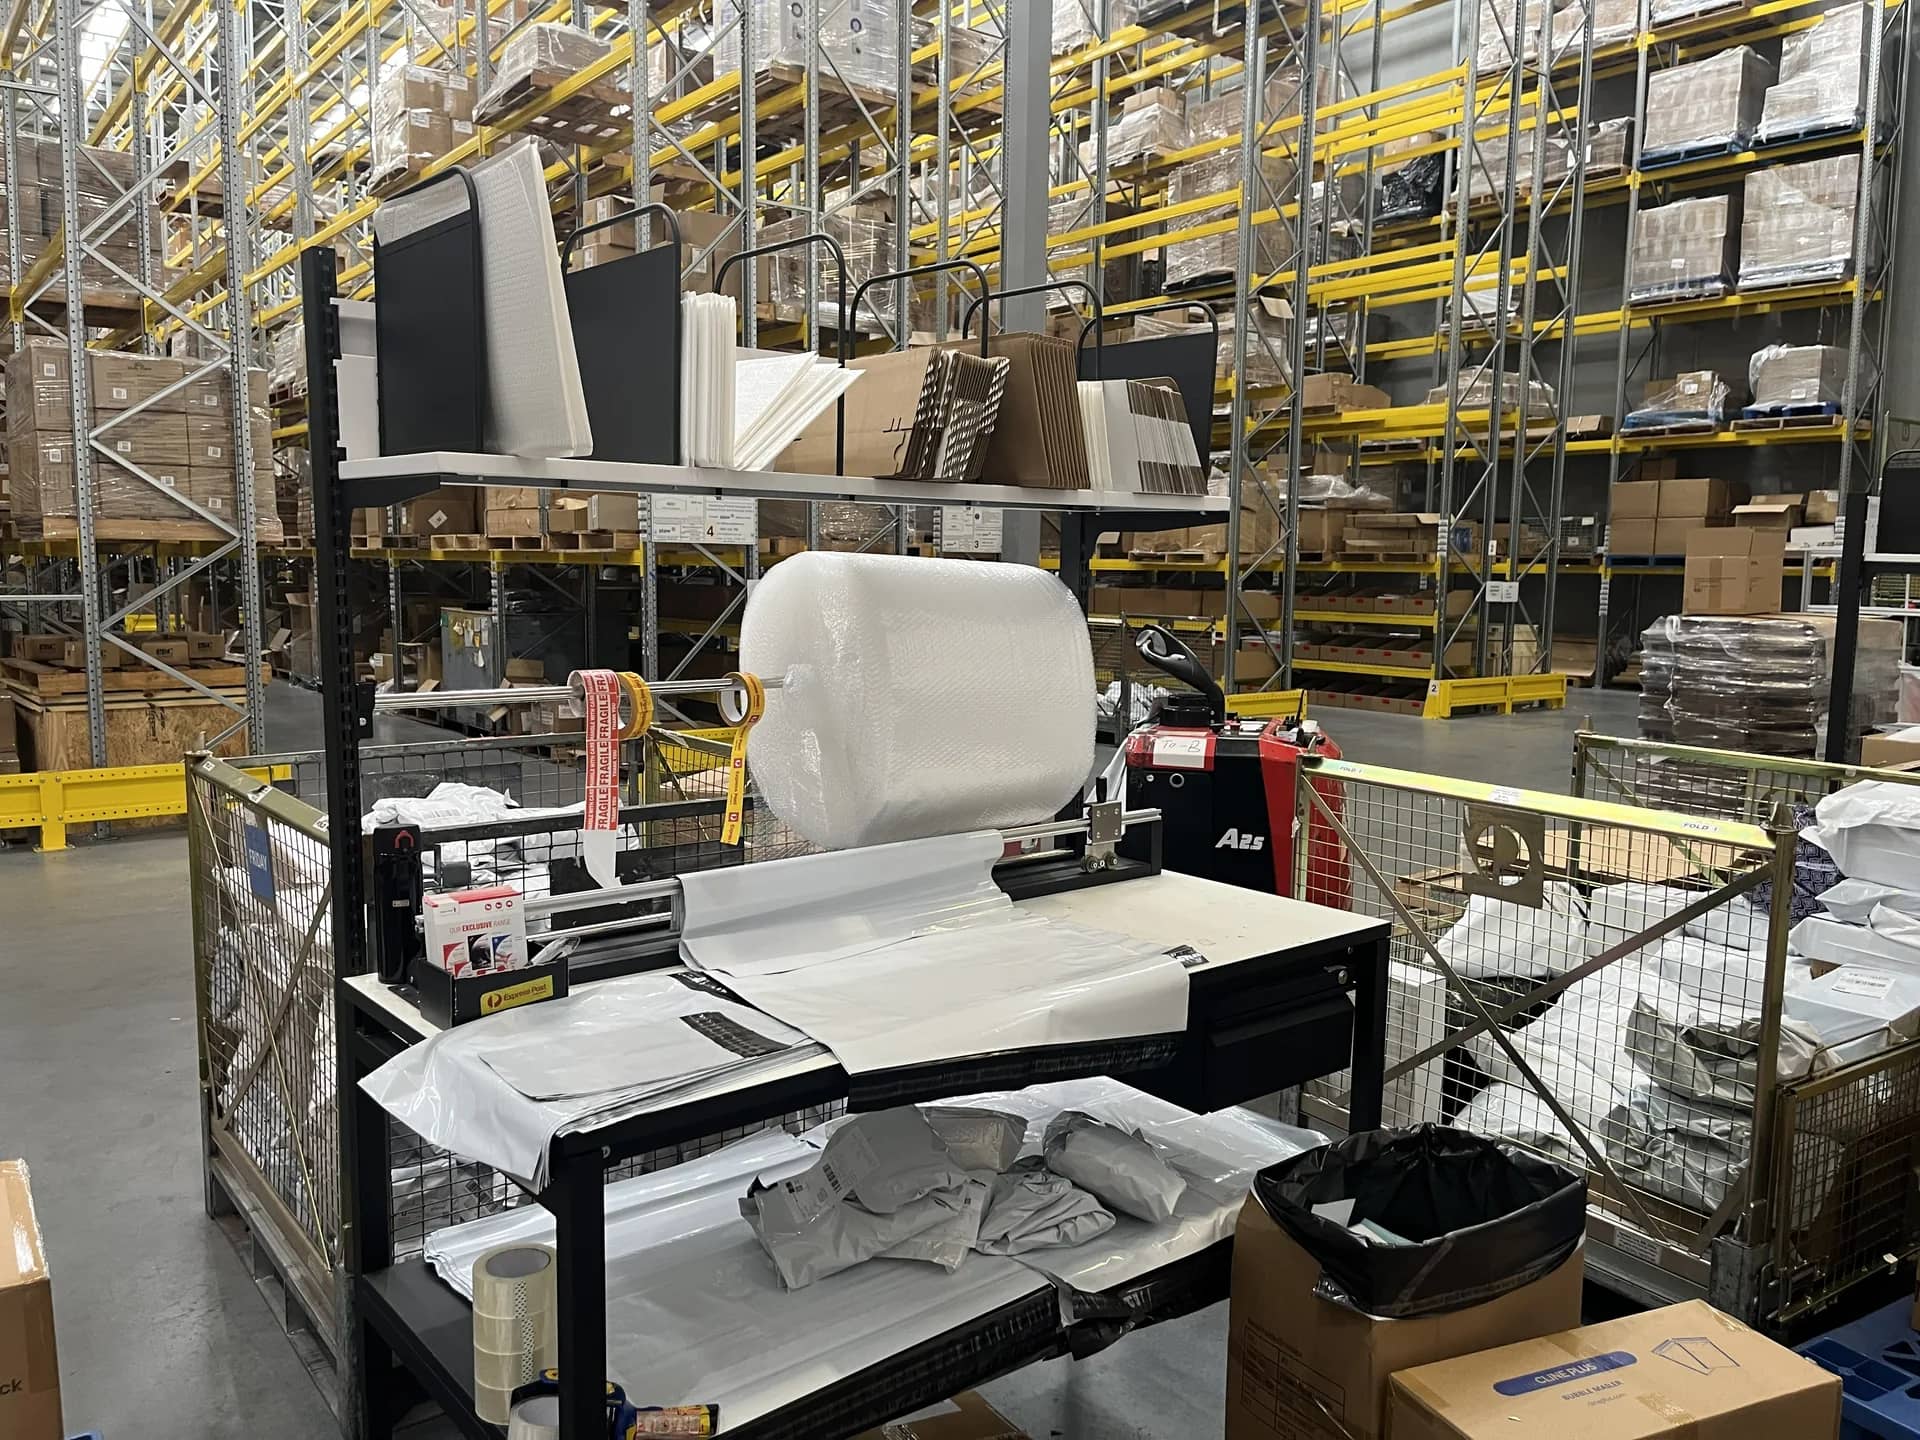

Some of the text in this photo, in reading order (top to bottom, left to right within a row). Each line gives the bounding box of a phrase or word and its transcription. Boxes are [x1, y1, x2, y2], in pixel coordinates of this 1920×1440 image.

[706, 525, 714, 537] 4
[974, 540, 979, 549] 3
[1431, 684, 1437, 692] 2
[599, 694, 609, 739] FRAGILE
[599, 741, 609, 786] FRAGILE
[598, 787, 609, 829] FRAGILE
[462, 921, 492, 932] EXCLUSIVE
[503, 987, 530, 1001] Express
[530, 983, 547, 994] Post
[1534, 1362, 1598, 1385] CLINE PLUS
[1561, 1387, 1593, 1401] BUBBLE
